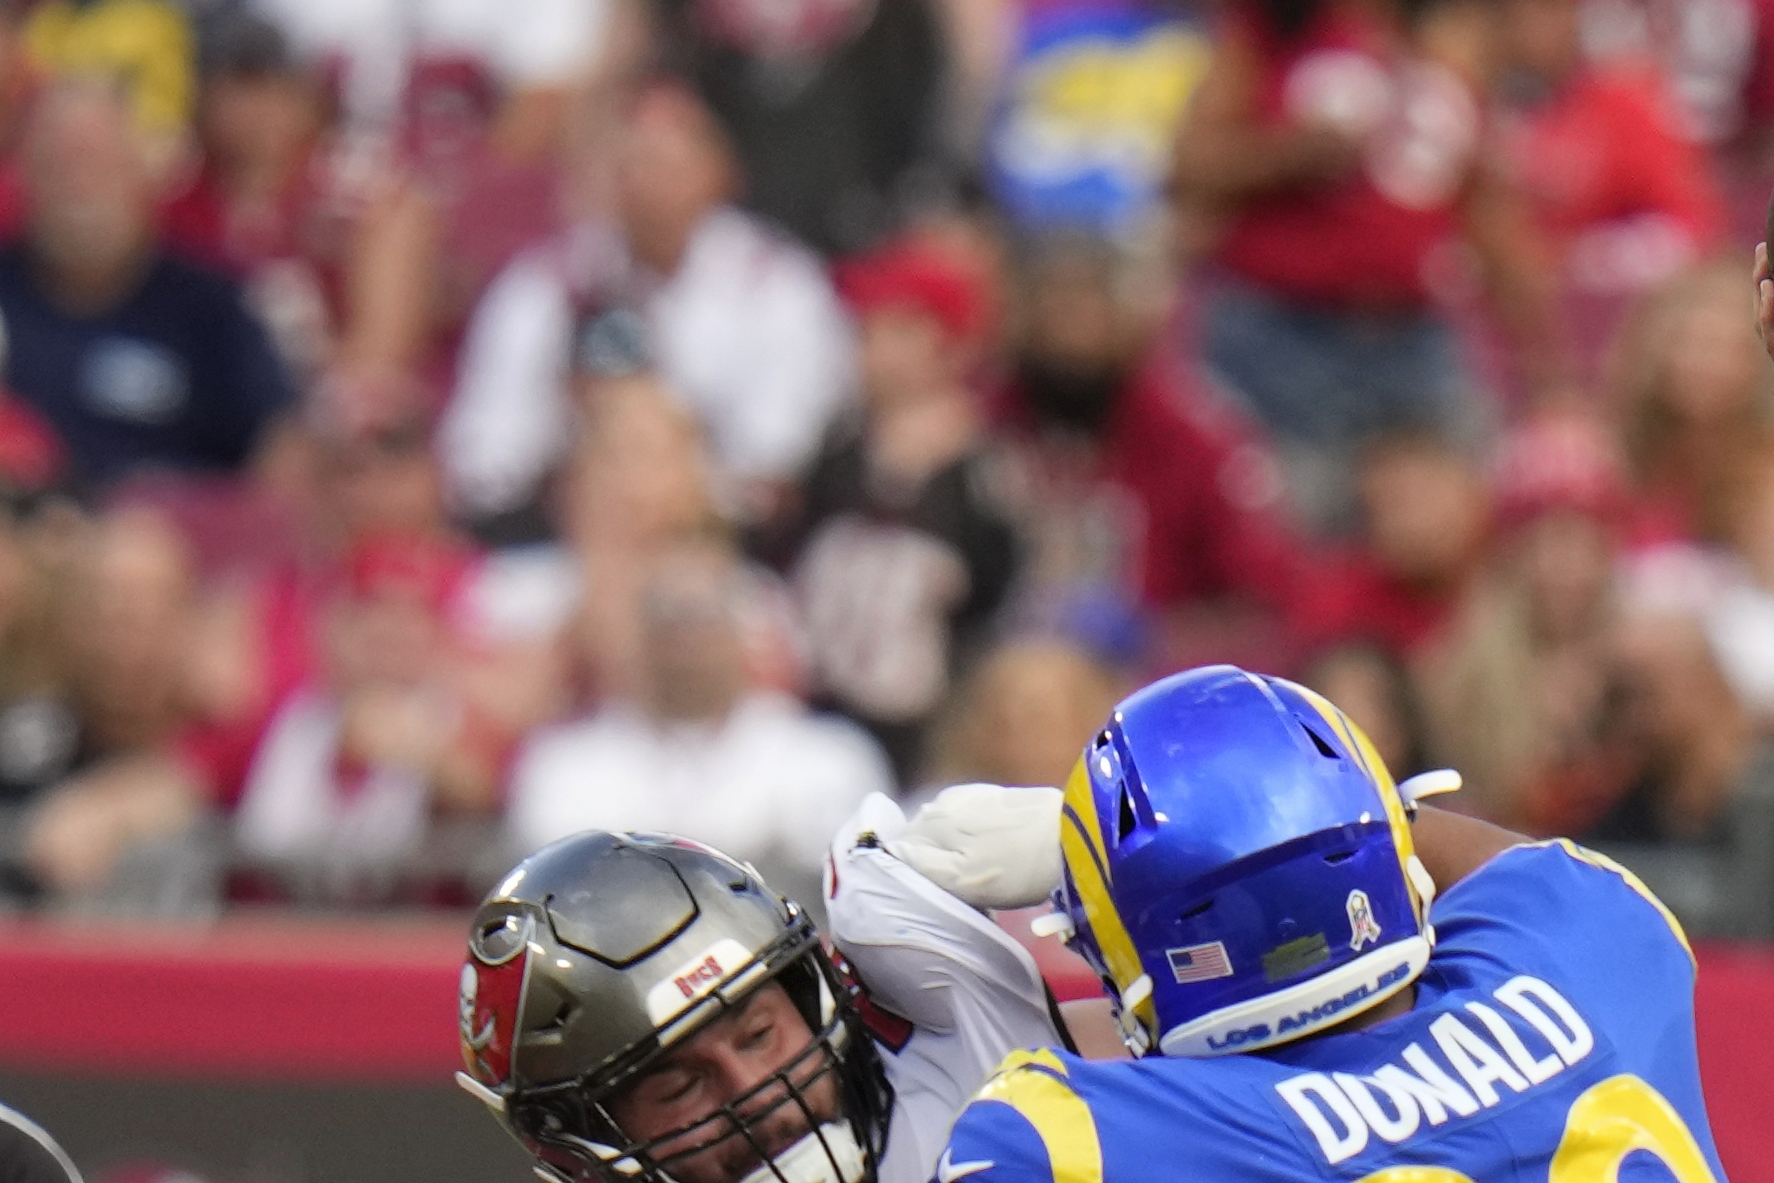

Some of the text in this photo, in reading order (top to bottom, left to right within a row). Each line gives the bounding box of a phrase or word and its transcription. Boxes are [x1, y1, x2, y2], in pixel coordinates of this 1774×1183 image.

[1207, 961, 1411, 1051] LOS ANGELES
[1275, 975, 1595, 1164] DONALD
